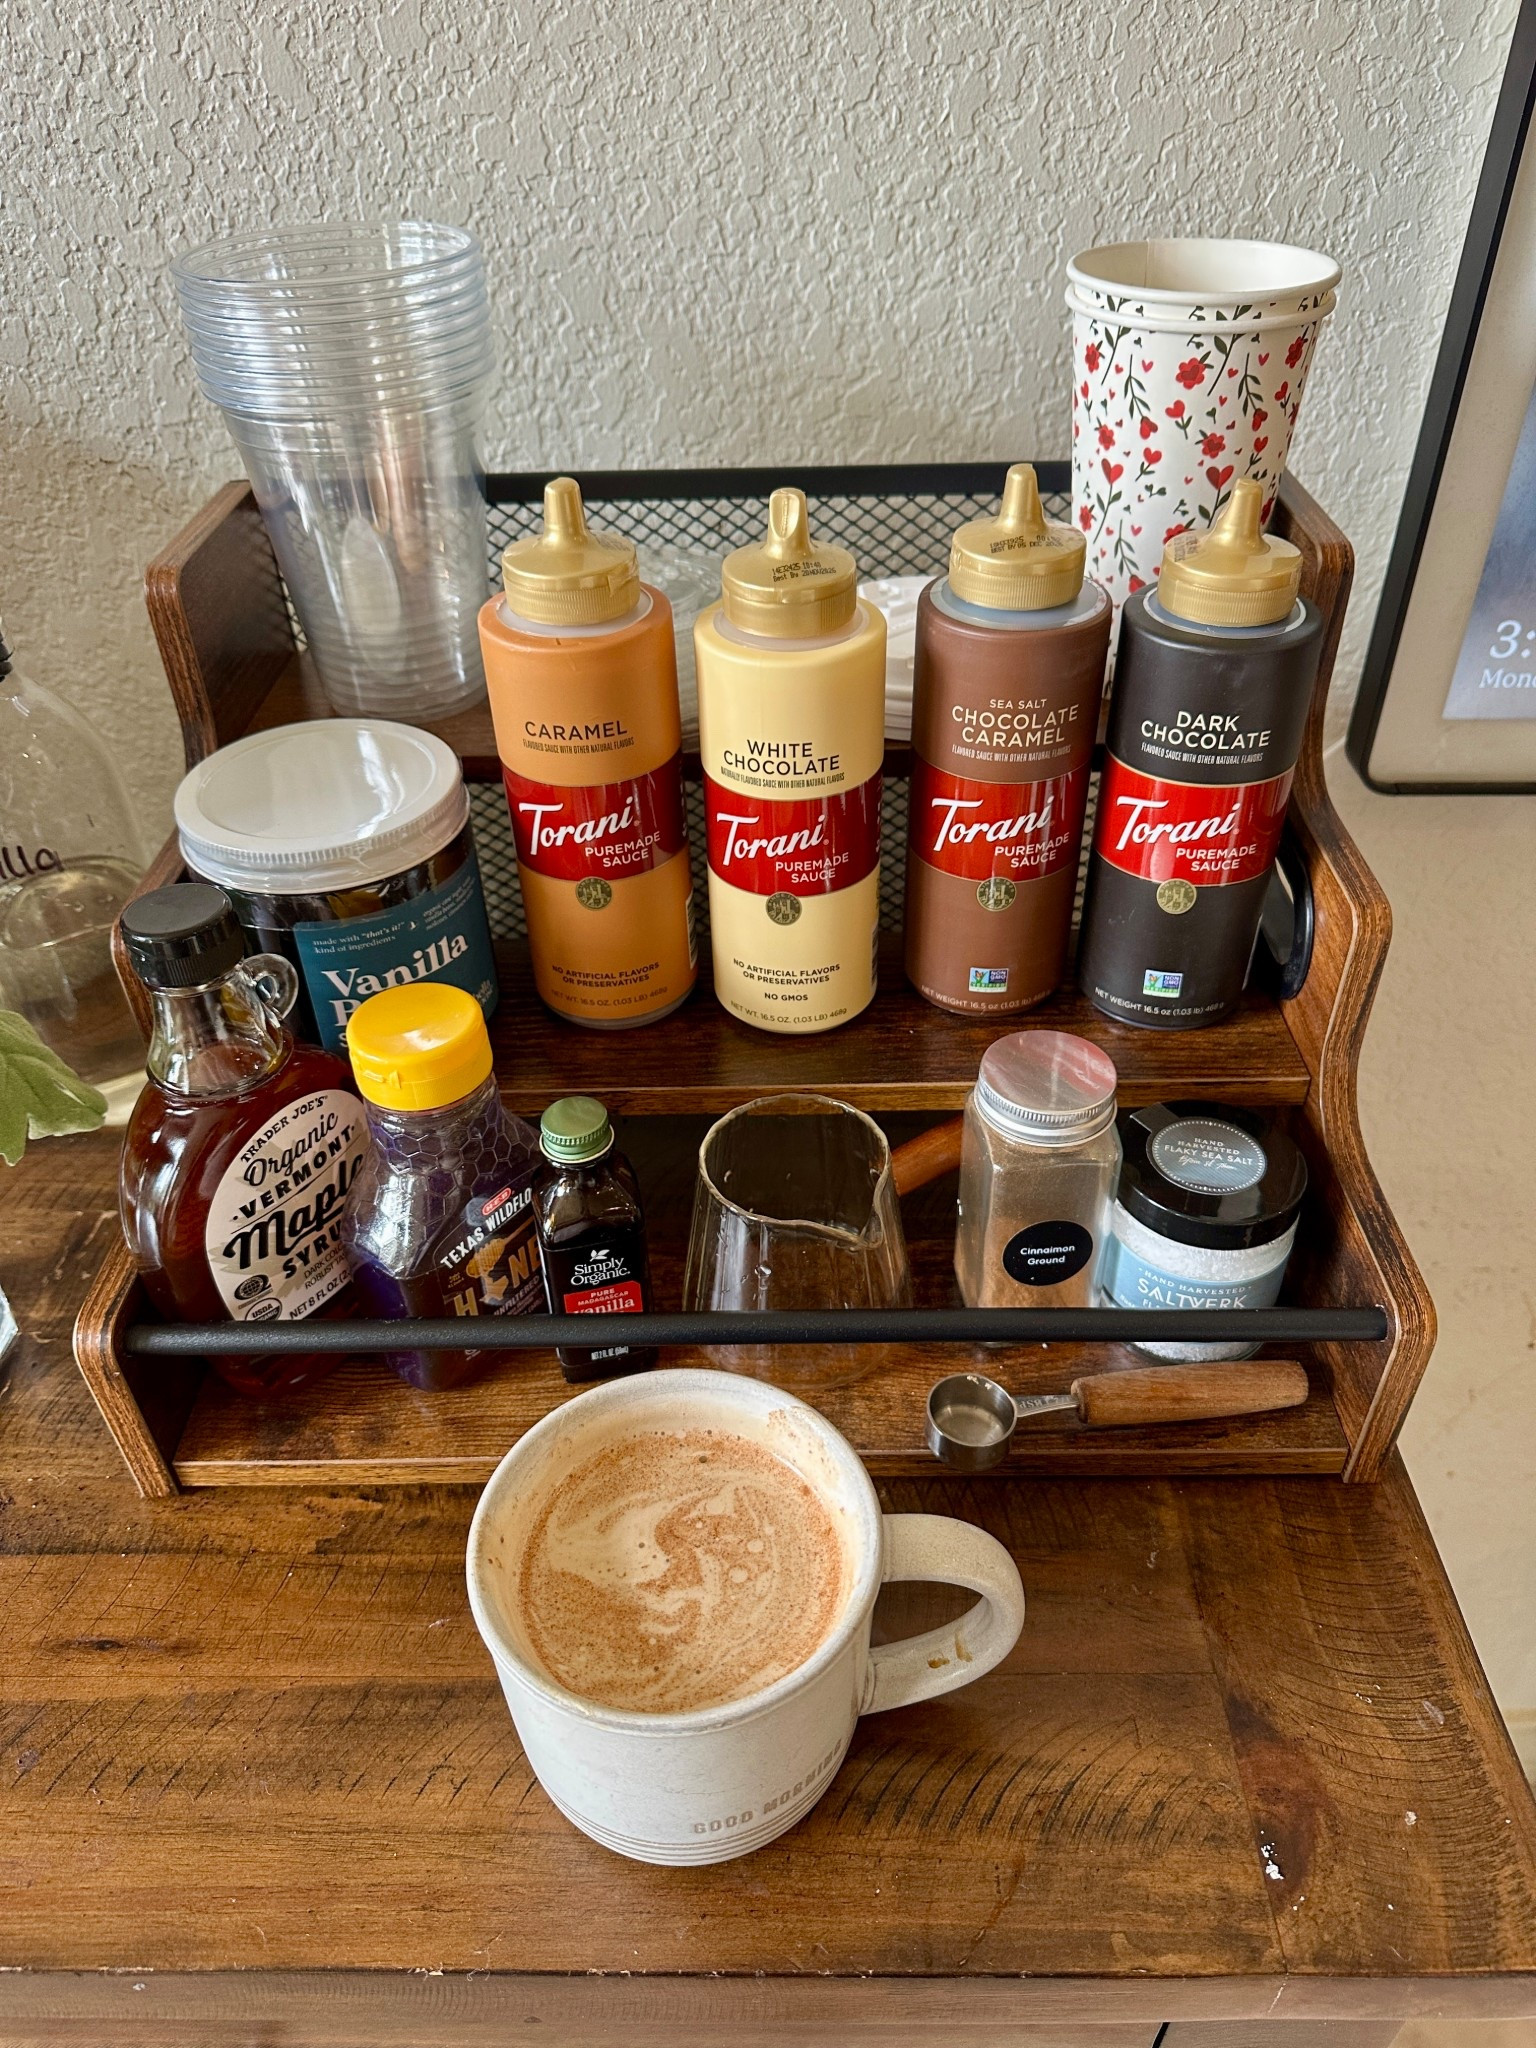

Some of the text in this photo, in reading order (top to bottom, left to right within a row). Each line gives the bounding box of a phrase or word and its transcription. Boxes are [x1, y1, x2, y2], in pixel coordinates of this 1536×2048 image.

[1479, 667, 1536, 688] Mon
[989, 698, 1048, 710] SEA SALT
[952, 703, 1080, 730] CHOCOLATE
[1176, 710, 1240, 732] DARK
[525, 720, 628, 741] CARAMEL
[962, 726, 1065, 748] CARAMEL
[1141, 720, 1271, 750] CHOCOLATE
[523, 737, 635, 754] FLAVORED SAUCE WITH OTHER NATURAL FLAVORS
[747, 739, 813, 758] WHITE
[952, 744, 1071, 763] FLAVORED SAUCE WITH OTHER NATURAL FLAVORS
[1141, 741, 1263, 765] FLAVORED SAUCE WITH OTHER NATURAL FLAVORS
[723, 750, 840, 776] CHOCOLATE
[720, 766, 845, 789] NATURALLY FLAVORED SAUCE WITH OTHER NATURAL FLAVORS
[518, 796, 634, 856] Torani
[931, 795, 1055, 852] Torani
[1116, 795, 1241, 851] Torani
[585, 831, 661, 857] PUREMADE
[716, 814, 826, 866] Torani
[994, 832, 1070, 856] PUREMADE
[603, 848, 649, 868] SAUCE
[775, 852, 849, 872] PUREMADE
[1010, 850, 1057, 868] SAUCE
[1176, 844, 1257, 860] PUREMADE
[1190, 858, 1241, 872] SAUCE
[791, 868, 836, 884] SAUCE
[312, 938, 337, 946] made
[339, 934, 360, 942] with
[314, 946, 336, 954] kind
[348, 936, 396, 951] ingredients
[321, 934, 469, 997] Vanilla
[552, 962, 660, 980] NO ARTIFICIAL FLAVORS
[733, 958, 841, 977] NO ARTIFICIAL FLAVORS
[562, 974, 650, 988] OR PRESERVATIVES
[742, 970, 830, 986] OR PRESERVATIVES
[764, 992, 778, 1001] NO
[921, 985, 934, 997] NET
[935, 992, 968, 1008] WEIGHT
[970, 1001, 986, 1010] 16.5
[1000, 1001, 1020, 1010] (1.03
[1095, 987, 1109, 999] NET
[1110, 995, 1142, 1011] WEIGHT
[1143, 1005, 1159, 1015] 16.5
[1173, 1008, 1191, 1017] (1.03
[1193, 1006, 1203, 1014] lb)
[730, 1000, 742, 1012] NET
[760, 1012, 775, 1022] 16.5
[793, 1014, 812, 1024] (1.03
[814, 1013, 828, 1022] LB)
[829, 1007, 848, 1018] 468g
[240, 1116, 290, 1163] TRADER
[244, 1113, 339, 1186] Organic
[1177, 1140, 1240, 1155] HARVESTED
[1194, 1137, 1224, 1147] HAND
[1164, 1144, 1198, 1156] FLAKY
[1201, 1150, 1223, 1161] SEA
[1227, 1155, 1253, 1166] SALT
[223, 1154, 363, 1270] Maple
[440, 1187, 533, 1270] TEXAS WILDFLO
[283, 1219, 341, 1279] SYRU
[304, 1260, 325, 1279] DARK
[574, 1257, 624, 1277] Simply
[1027, 1255, 1066, 1265] Ground
[305, 1261, 334, 1289] ROBUST
[1144, 1270, 1246, 1295] HAND HARVESTED
[289, 1301, 308, 1320] NET
[309, 1296, 316, 1307] 8
[316, 1288, 327, 1302] FL
[326, 1279, 340, 1292] OZ
[577, 1290, 629, 1306] MADAGASCAR
[590, 1288, 615, 1299] PURE
[252, 1303, 273, 1318] USDA
[574, 1297, 635, 1313] anilla
[693, 1810, 754, 1834] GOOD
